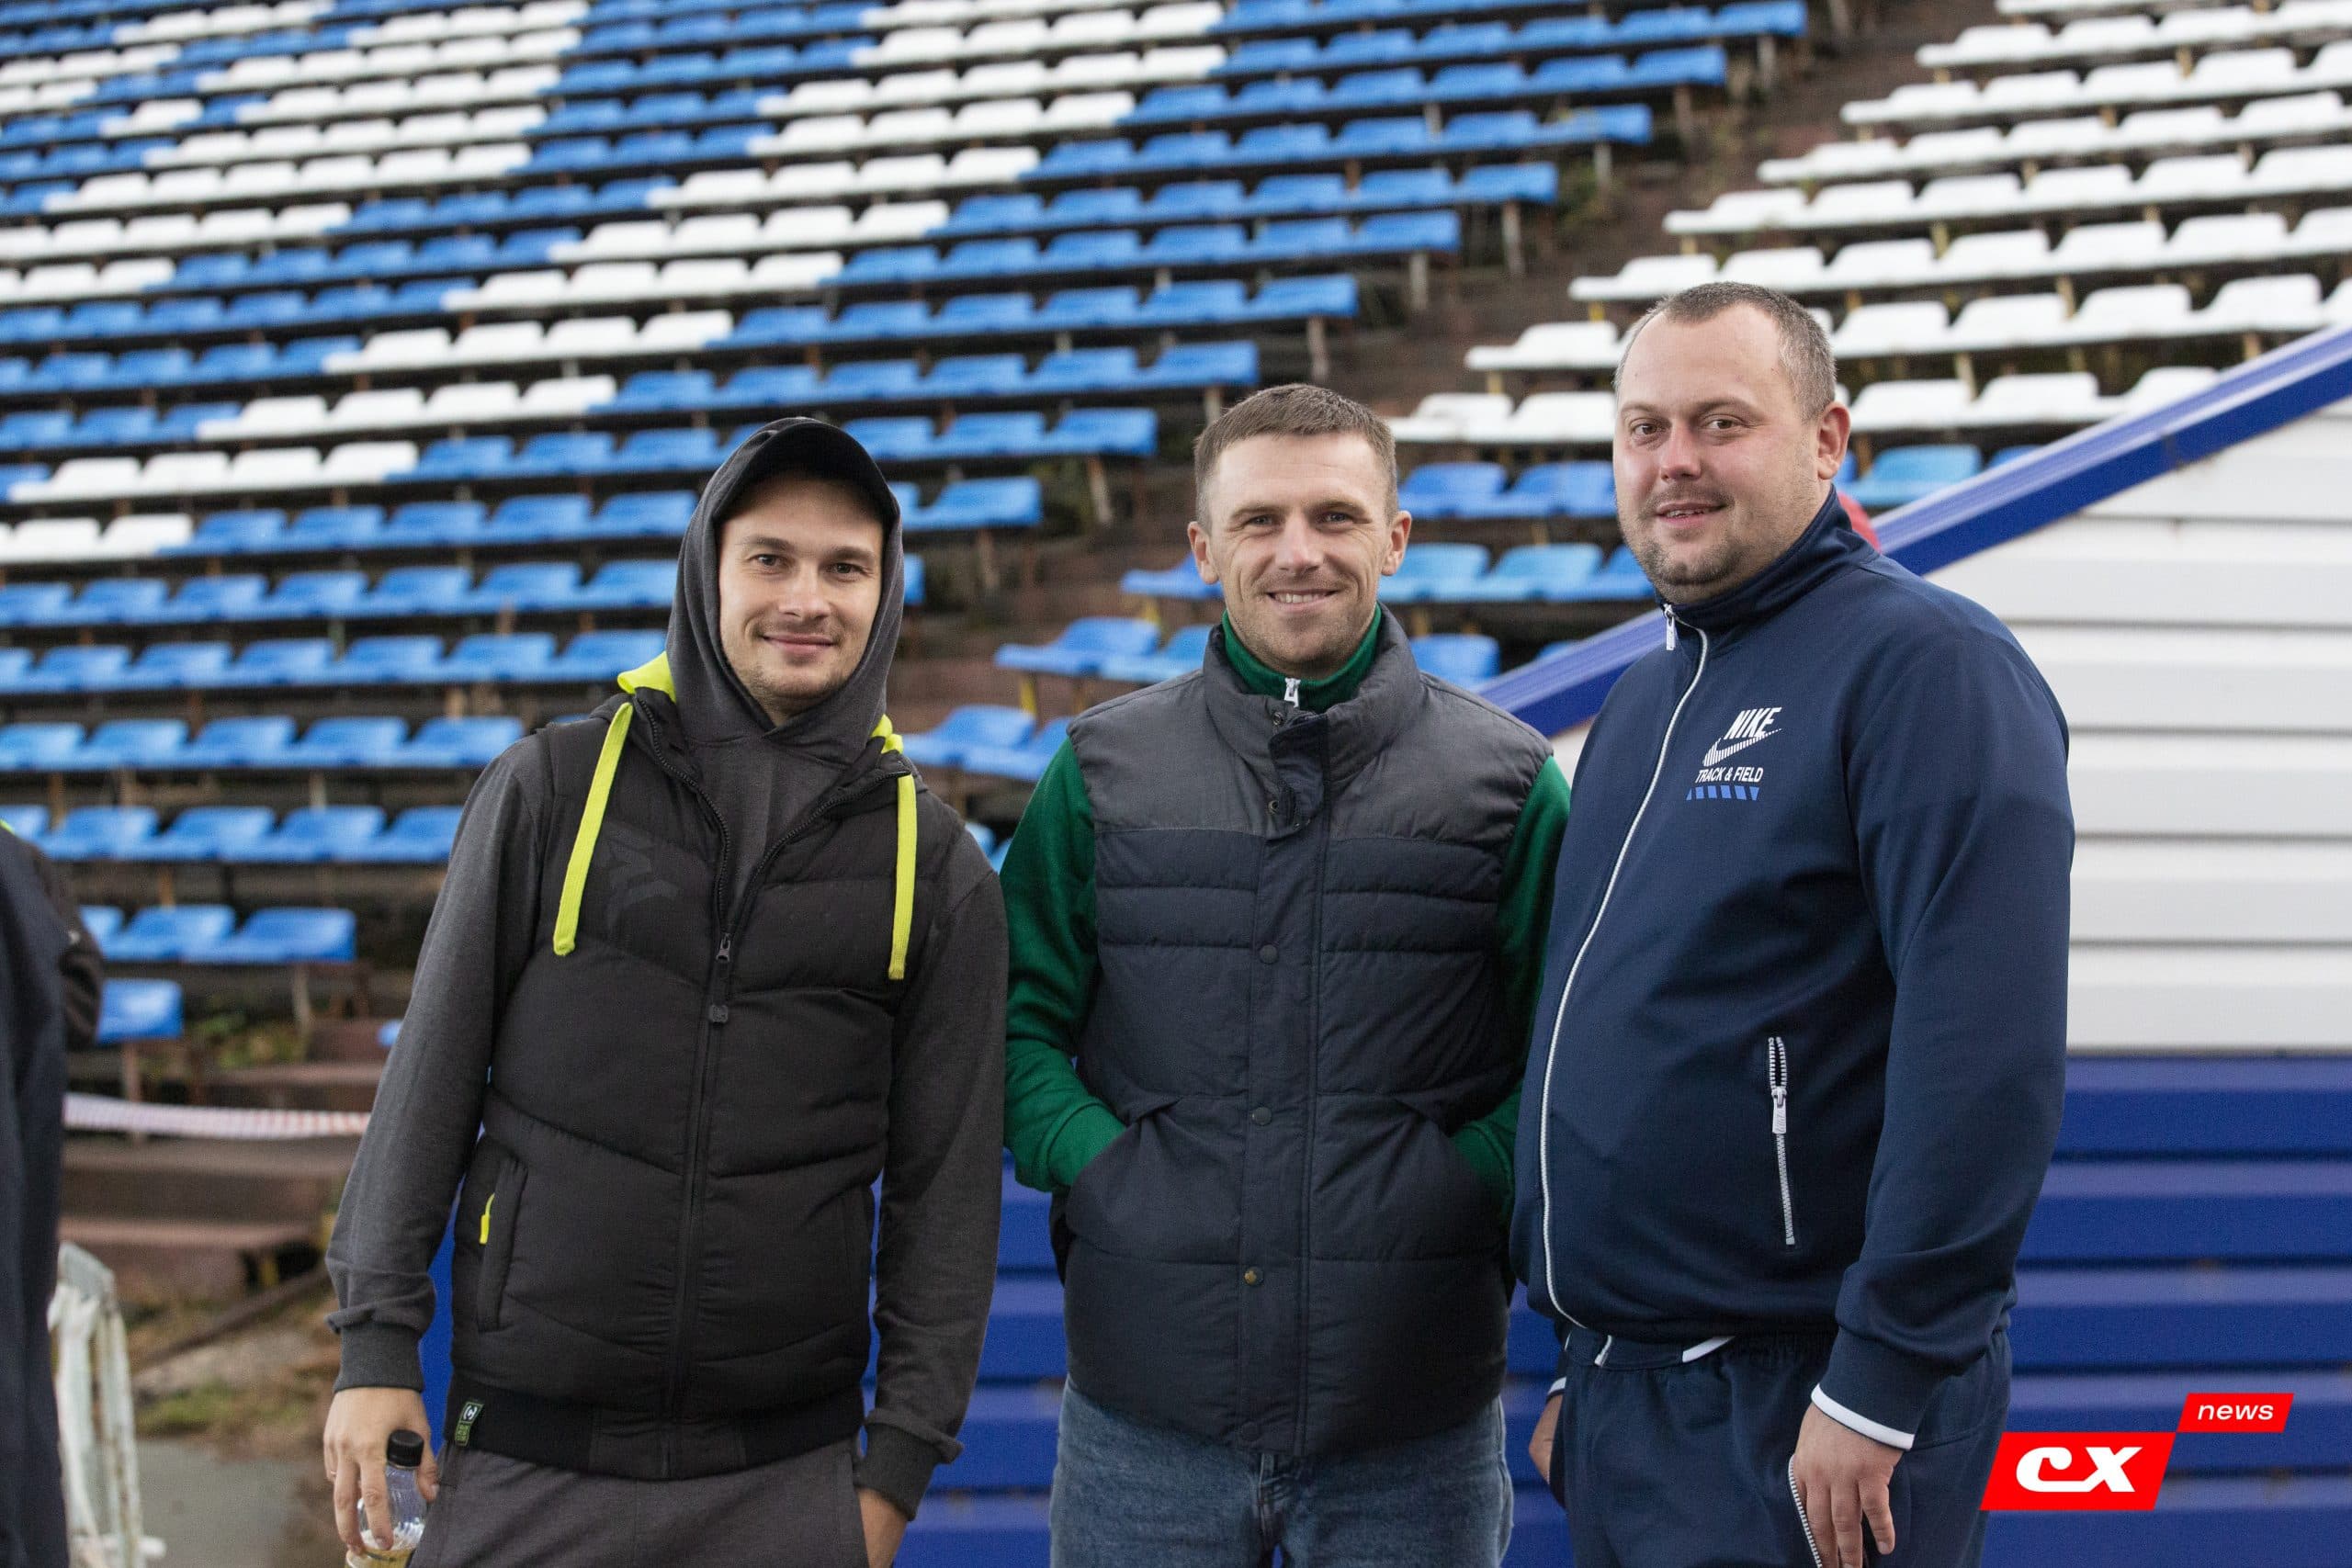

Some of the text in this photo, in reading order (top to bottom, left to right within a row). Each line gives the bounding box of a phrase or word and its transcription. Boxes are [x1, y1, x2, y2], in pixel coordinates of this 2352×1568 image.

[1724, 706, 1782, 740] NIKE
[1695, 766, 1764, 783] TRACK & FIELD
